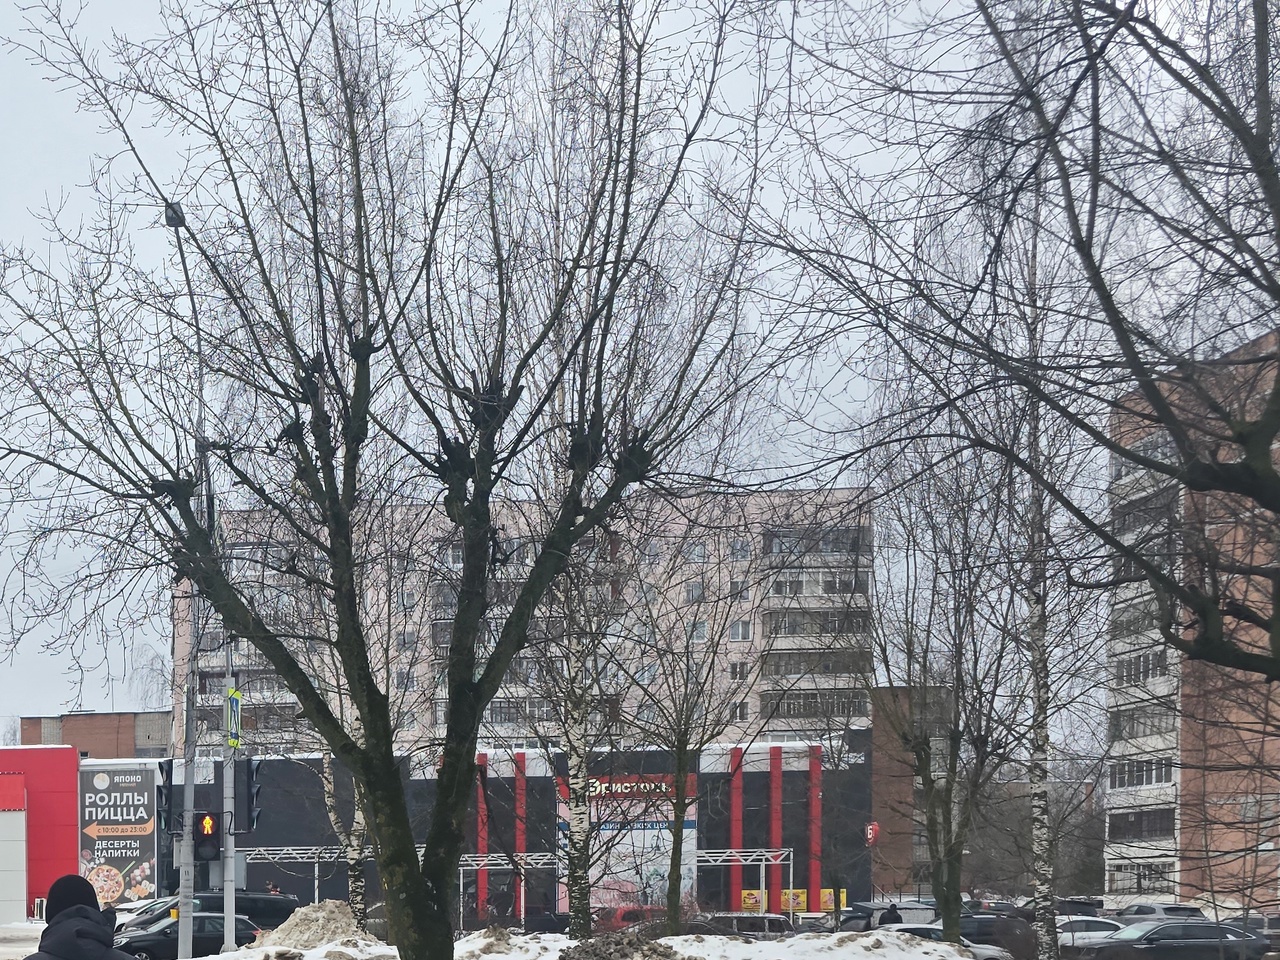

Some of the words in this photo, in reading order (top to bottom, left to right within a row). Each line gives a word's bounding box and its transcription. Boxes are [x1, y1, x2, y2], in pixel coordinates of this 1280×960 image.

[114, 775, 142, 783] ЯПОНО
[85, 792, 148, 806] РОЛЛЫ
[85, 807, 148, 821] ПИЦЦА
[94, 840, 140, 849] ДЕСЕРТЫ
[94, 849, 140, 857] НАПИТКИ
